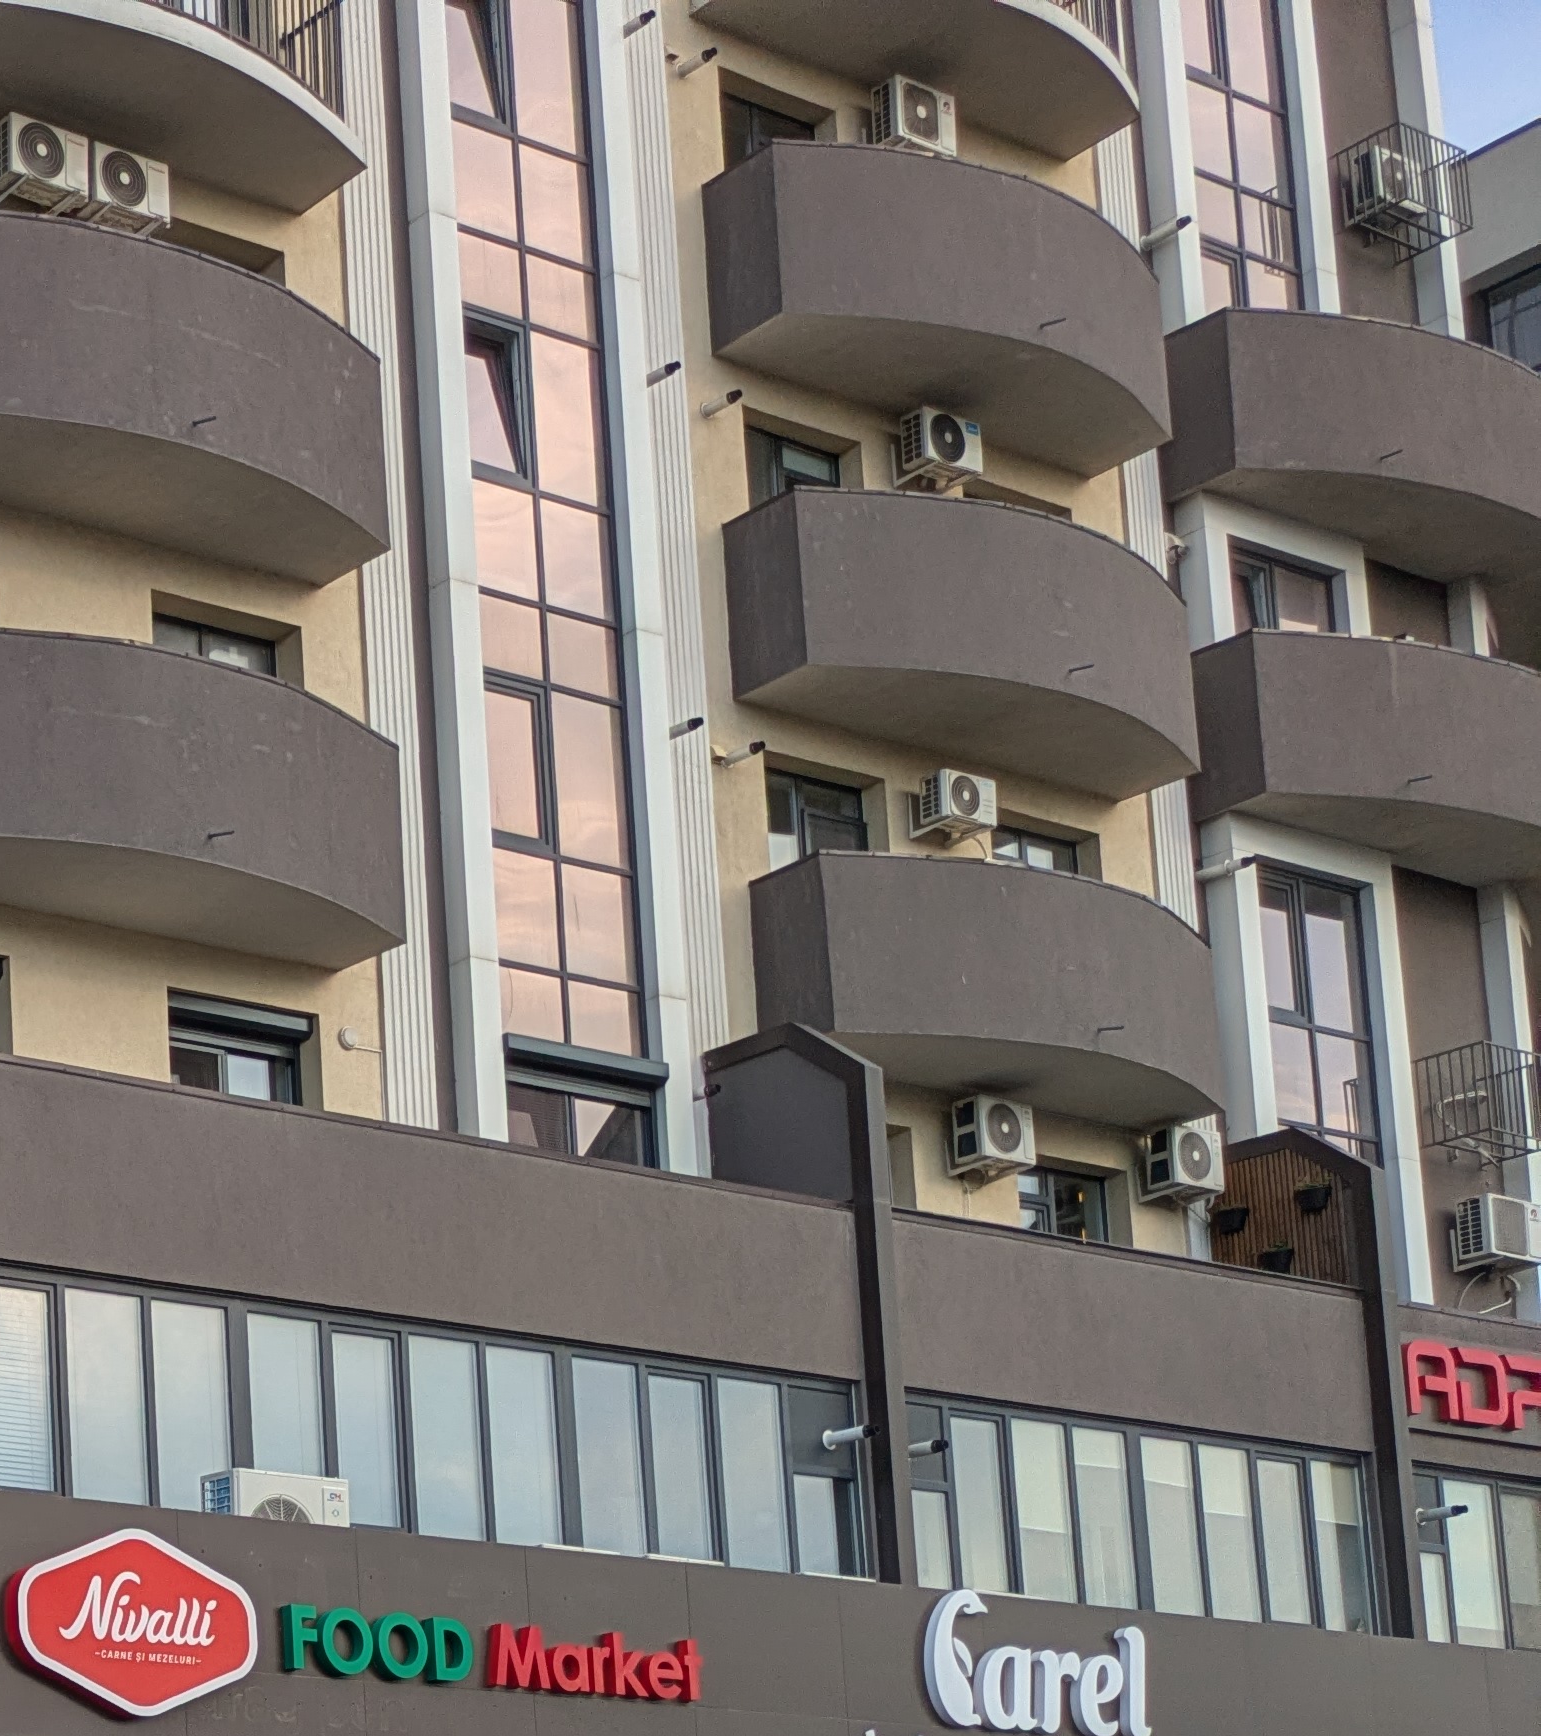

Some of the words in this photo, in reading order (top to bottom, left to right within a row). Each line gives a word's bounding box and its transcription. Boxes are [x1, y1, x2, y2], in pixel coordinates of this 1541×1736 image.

[59, 1571, 217, 1646] Nivalli
[279, 1603, 473, 1682] FOOD
[487, 1622, 703, 1702] Market
